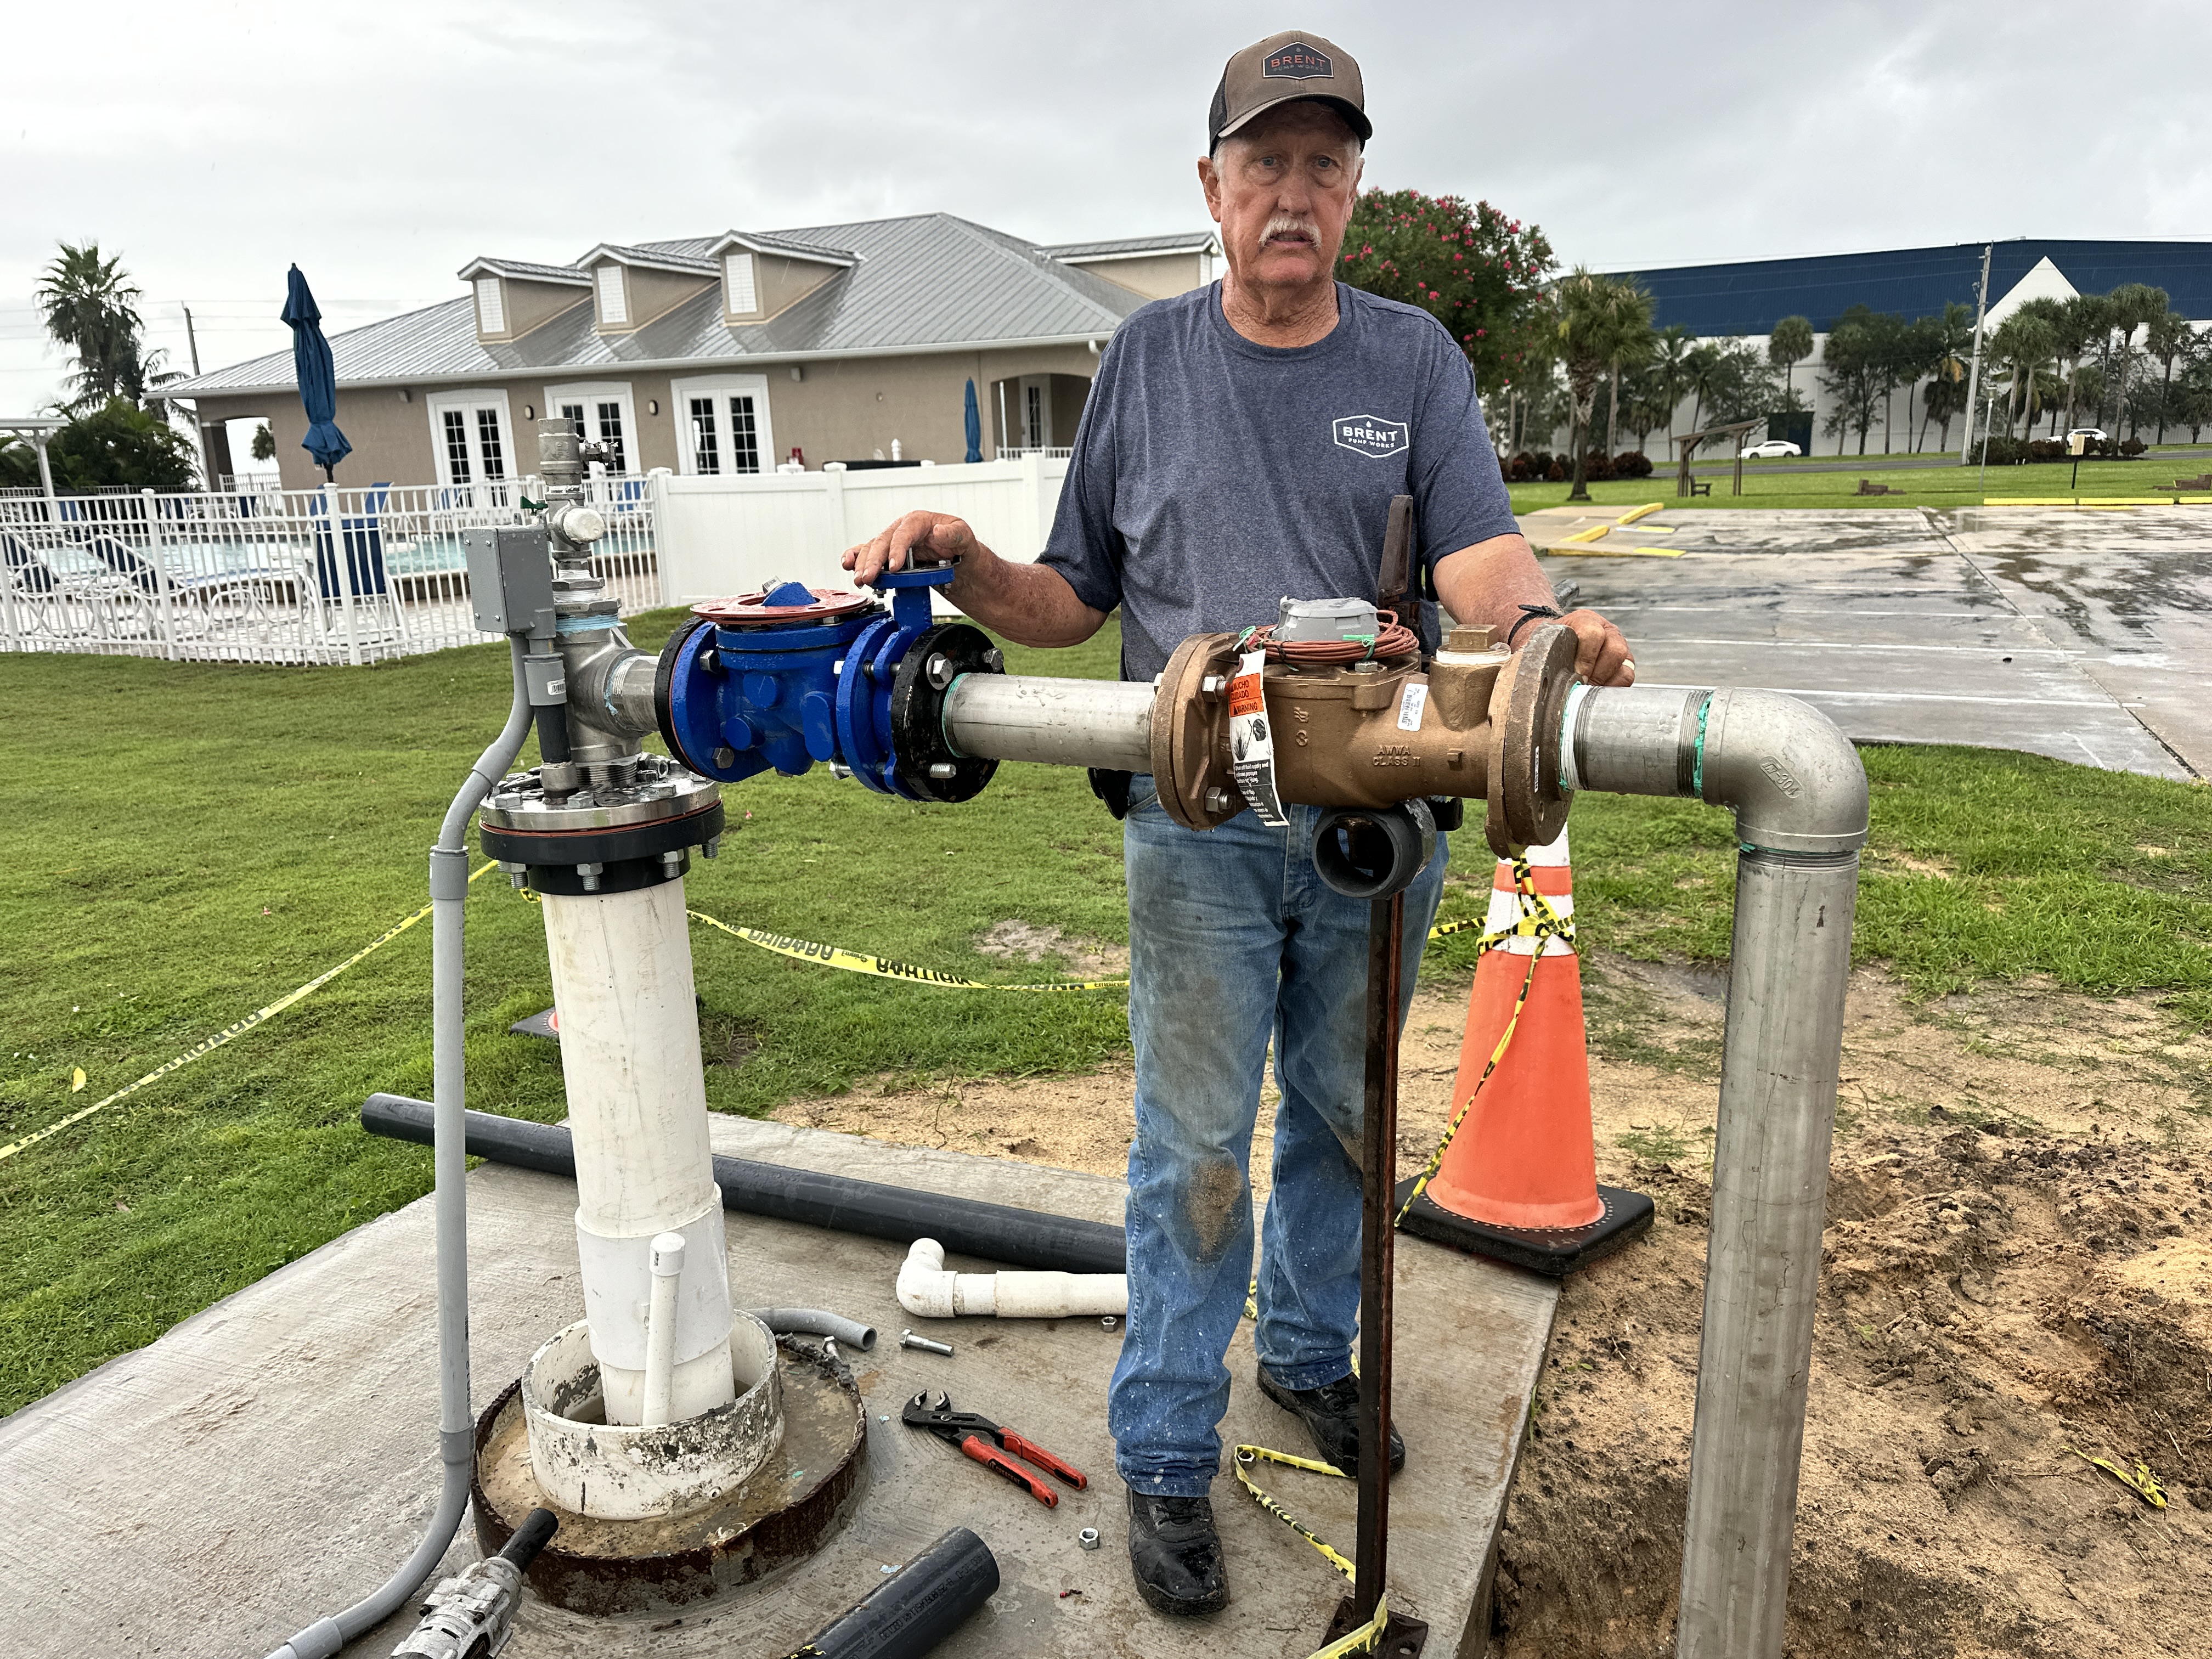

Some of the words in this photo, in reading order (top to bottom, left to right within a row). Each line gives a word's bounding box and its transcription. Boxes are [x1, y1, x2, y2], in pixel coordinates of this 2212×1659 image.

[1271, 55, 1325, 68] BRENT
[1297, 64, 1324, 72] WORKS
[1342, 426, 1398, 442] BRENT
[1376, 744, 1411, 755] AWWA
[1373, 756, 1409, 766] CLASS
